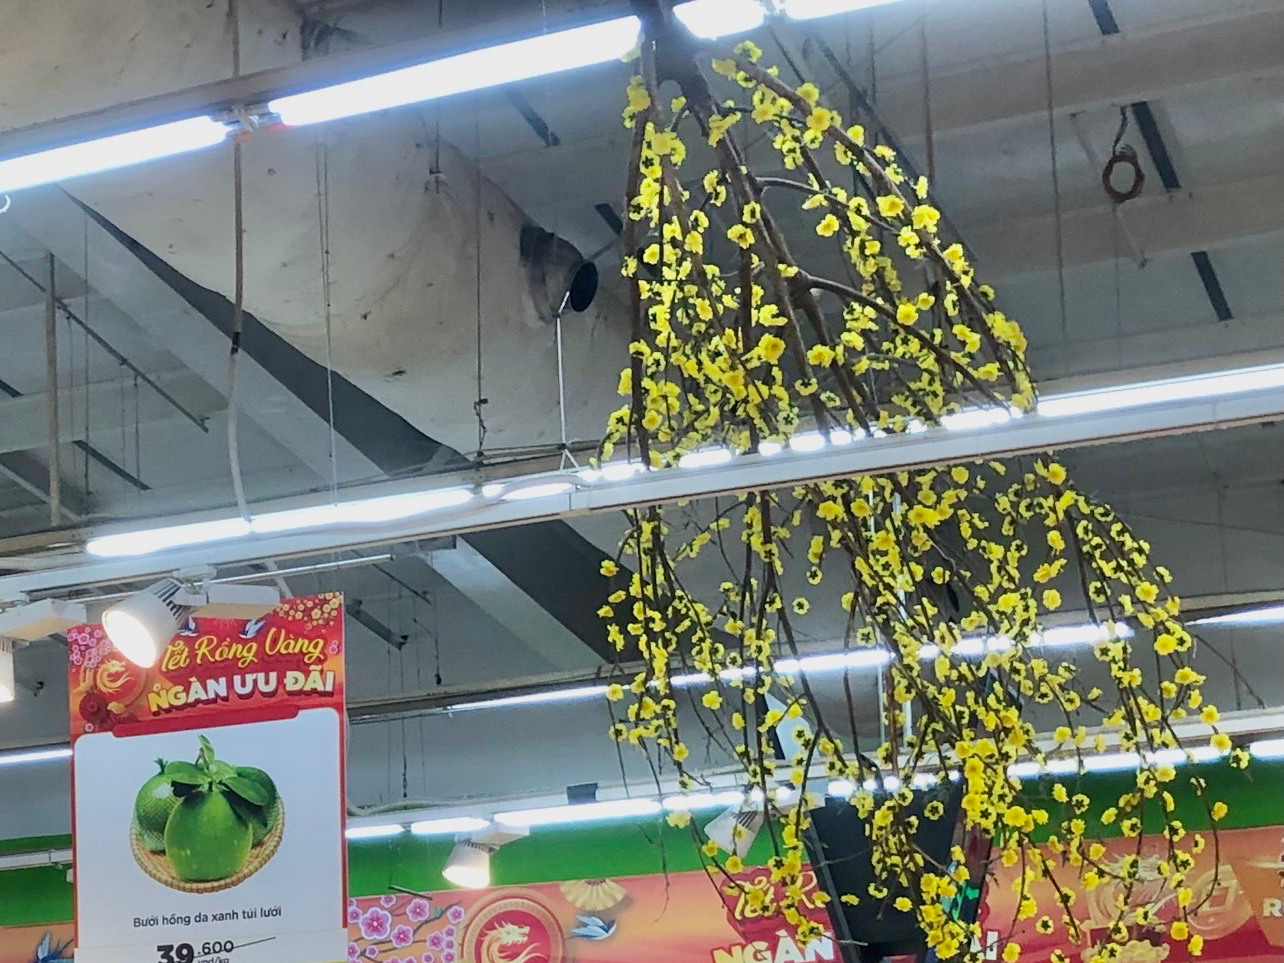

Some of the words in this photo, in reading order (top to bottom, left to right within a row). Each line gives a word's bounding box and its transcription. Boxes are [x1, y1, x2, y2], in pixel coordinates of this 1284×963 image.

[194, 635, 258, 668] Rồng
[265, 627, 324, 663] Vàng
[147, 676, 228, 713] NGÀN
[233, 671, 277, 696] ƯU
[284, 665, 336, 692] ĐÃI
[133, 916, 158, 928] Bưởi
[162, 912, 191, 926] hồng
[194, 911, 208, 923] da
[211, 909, 239, 921] xanh
[242, 908, 258, 920] túi
[260, 906, 282, 918] lưới
